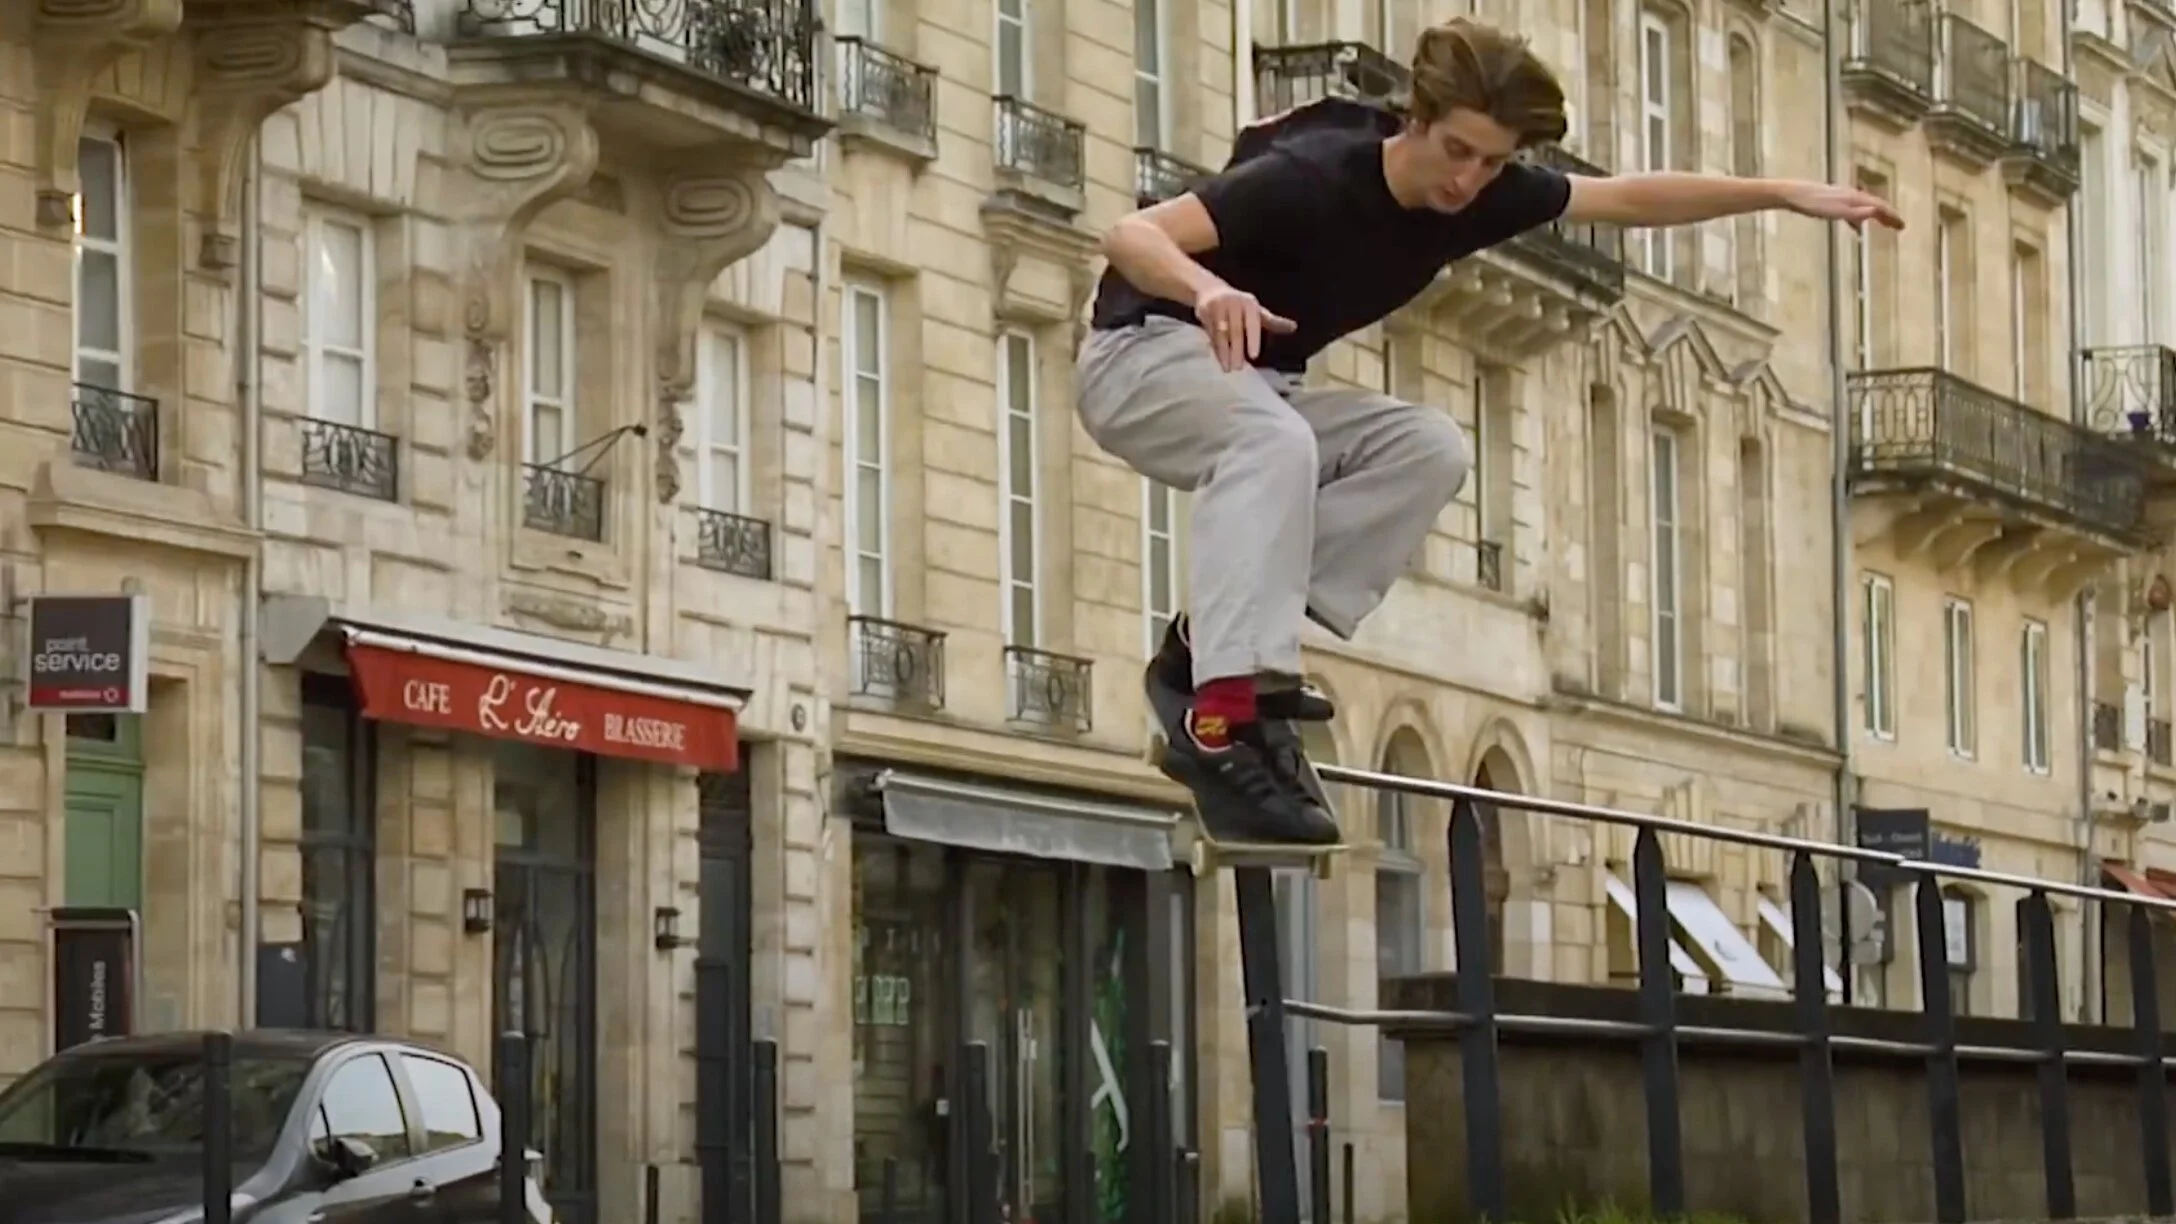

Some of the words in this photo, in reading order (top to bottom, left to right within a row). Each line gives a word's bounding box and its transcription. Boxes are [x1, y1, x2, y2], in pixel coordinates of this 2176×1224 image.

[35, 652, 121, 672] service
[403, 679, 452, 715] CAFE
[604, 713, 687, 751] BRASSERIE
